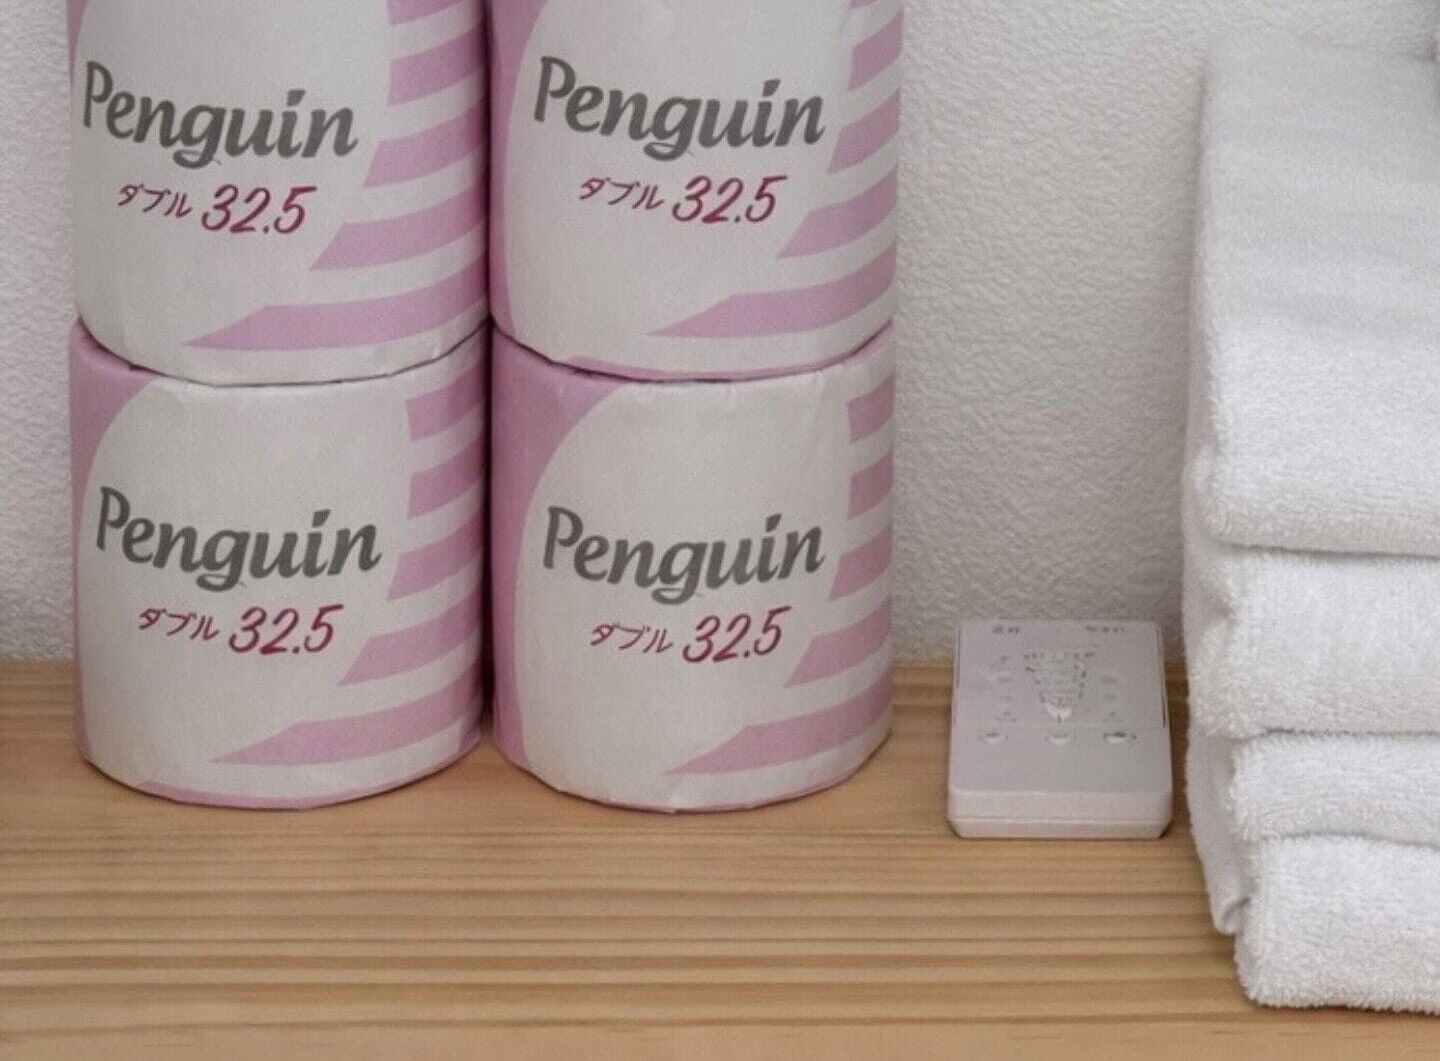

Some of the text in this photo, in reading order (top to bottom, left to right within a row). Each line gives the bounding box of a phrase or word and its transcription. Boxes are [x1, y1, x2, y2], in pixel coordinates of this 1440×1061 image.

[82, 60, 360, 169] Penguin
[533, 56, 826, 161] Penguin
[117, 182, 318, 235] ダブル 32.5
[578, 174, 788, 225] ダブル 32.5
[96, 485, 382, 592] Penguin
[542, 506, 826, 605] Penguin
[138, 603, 345, 656] ダブル 32.5
[590, 606, 792, 663] ダブル 32.5
